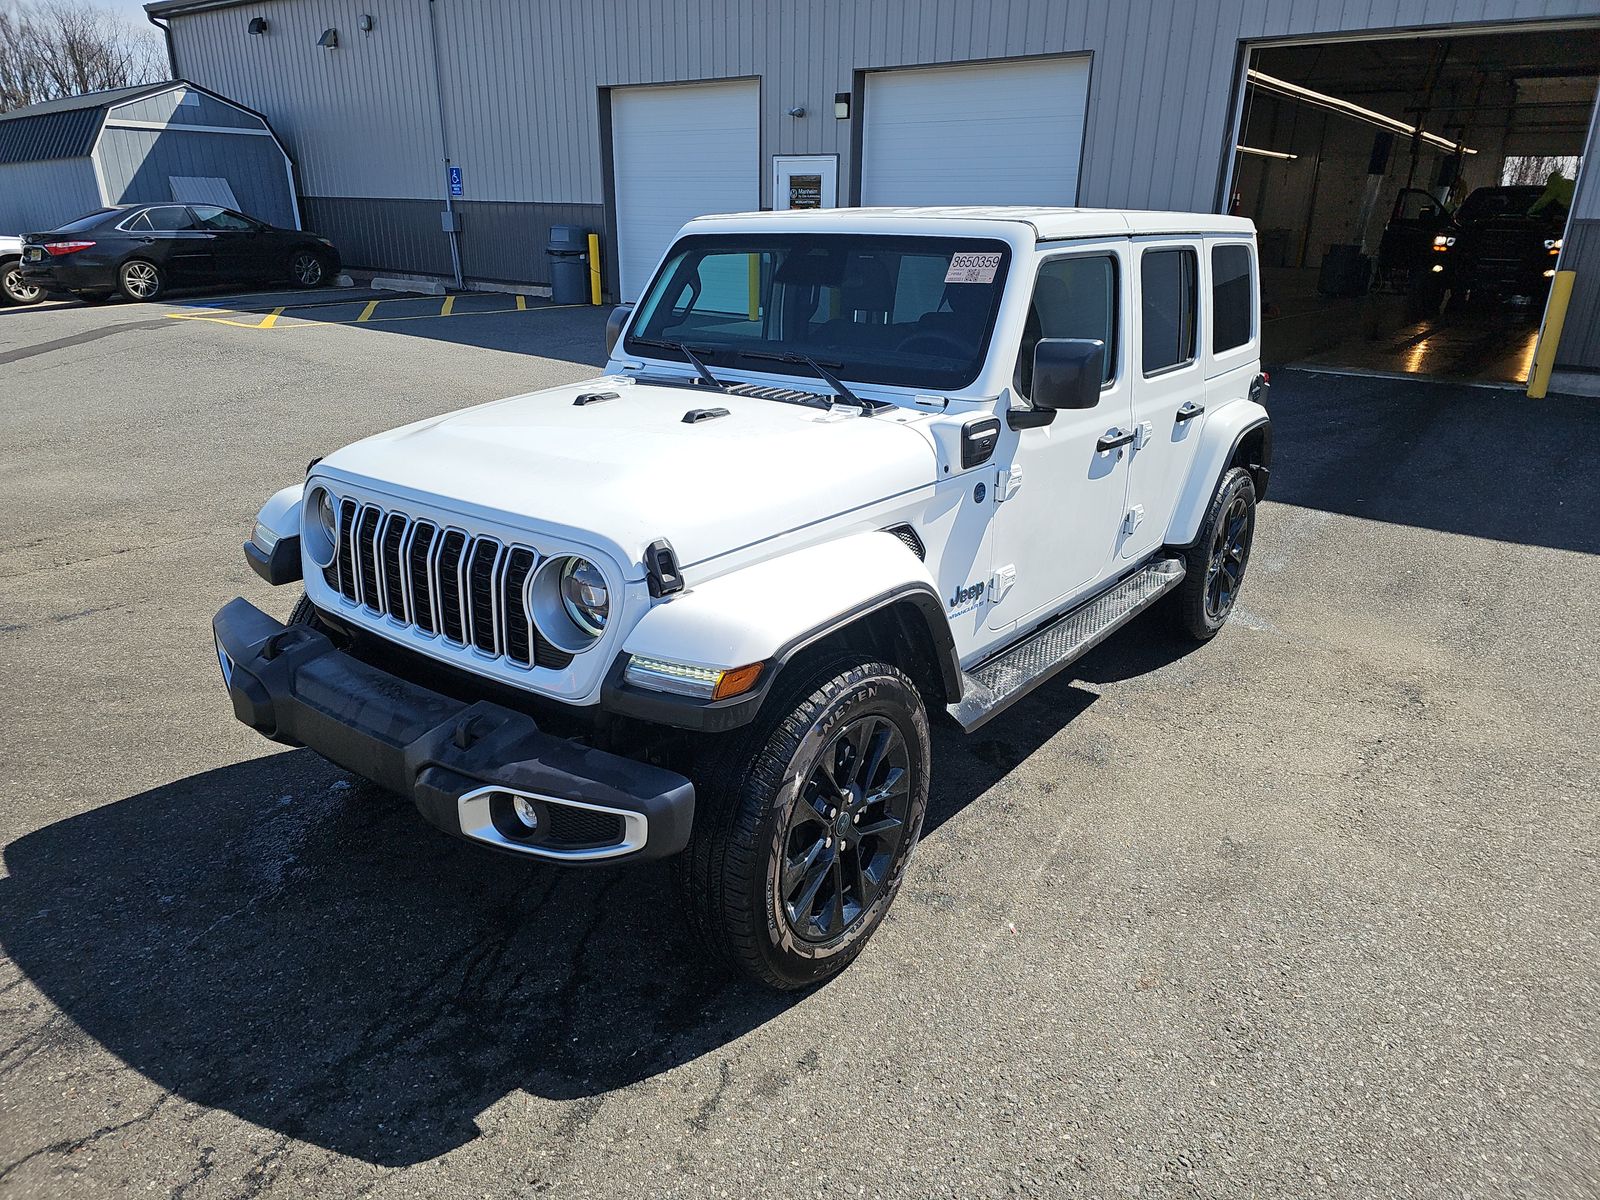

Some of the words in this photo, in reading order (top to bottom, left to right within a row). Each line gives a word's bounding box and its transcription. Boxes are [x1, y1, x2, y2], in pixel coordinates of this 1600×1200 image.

[952, 255, 1000, 268] 8650359
[950, 581, 985, 608] Jeep
[822, 685, 878, 734] NEXEN
